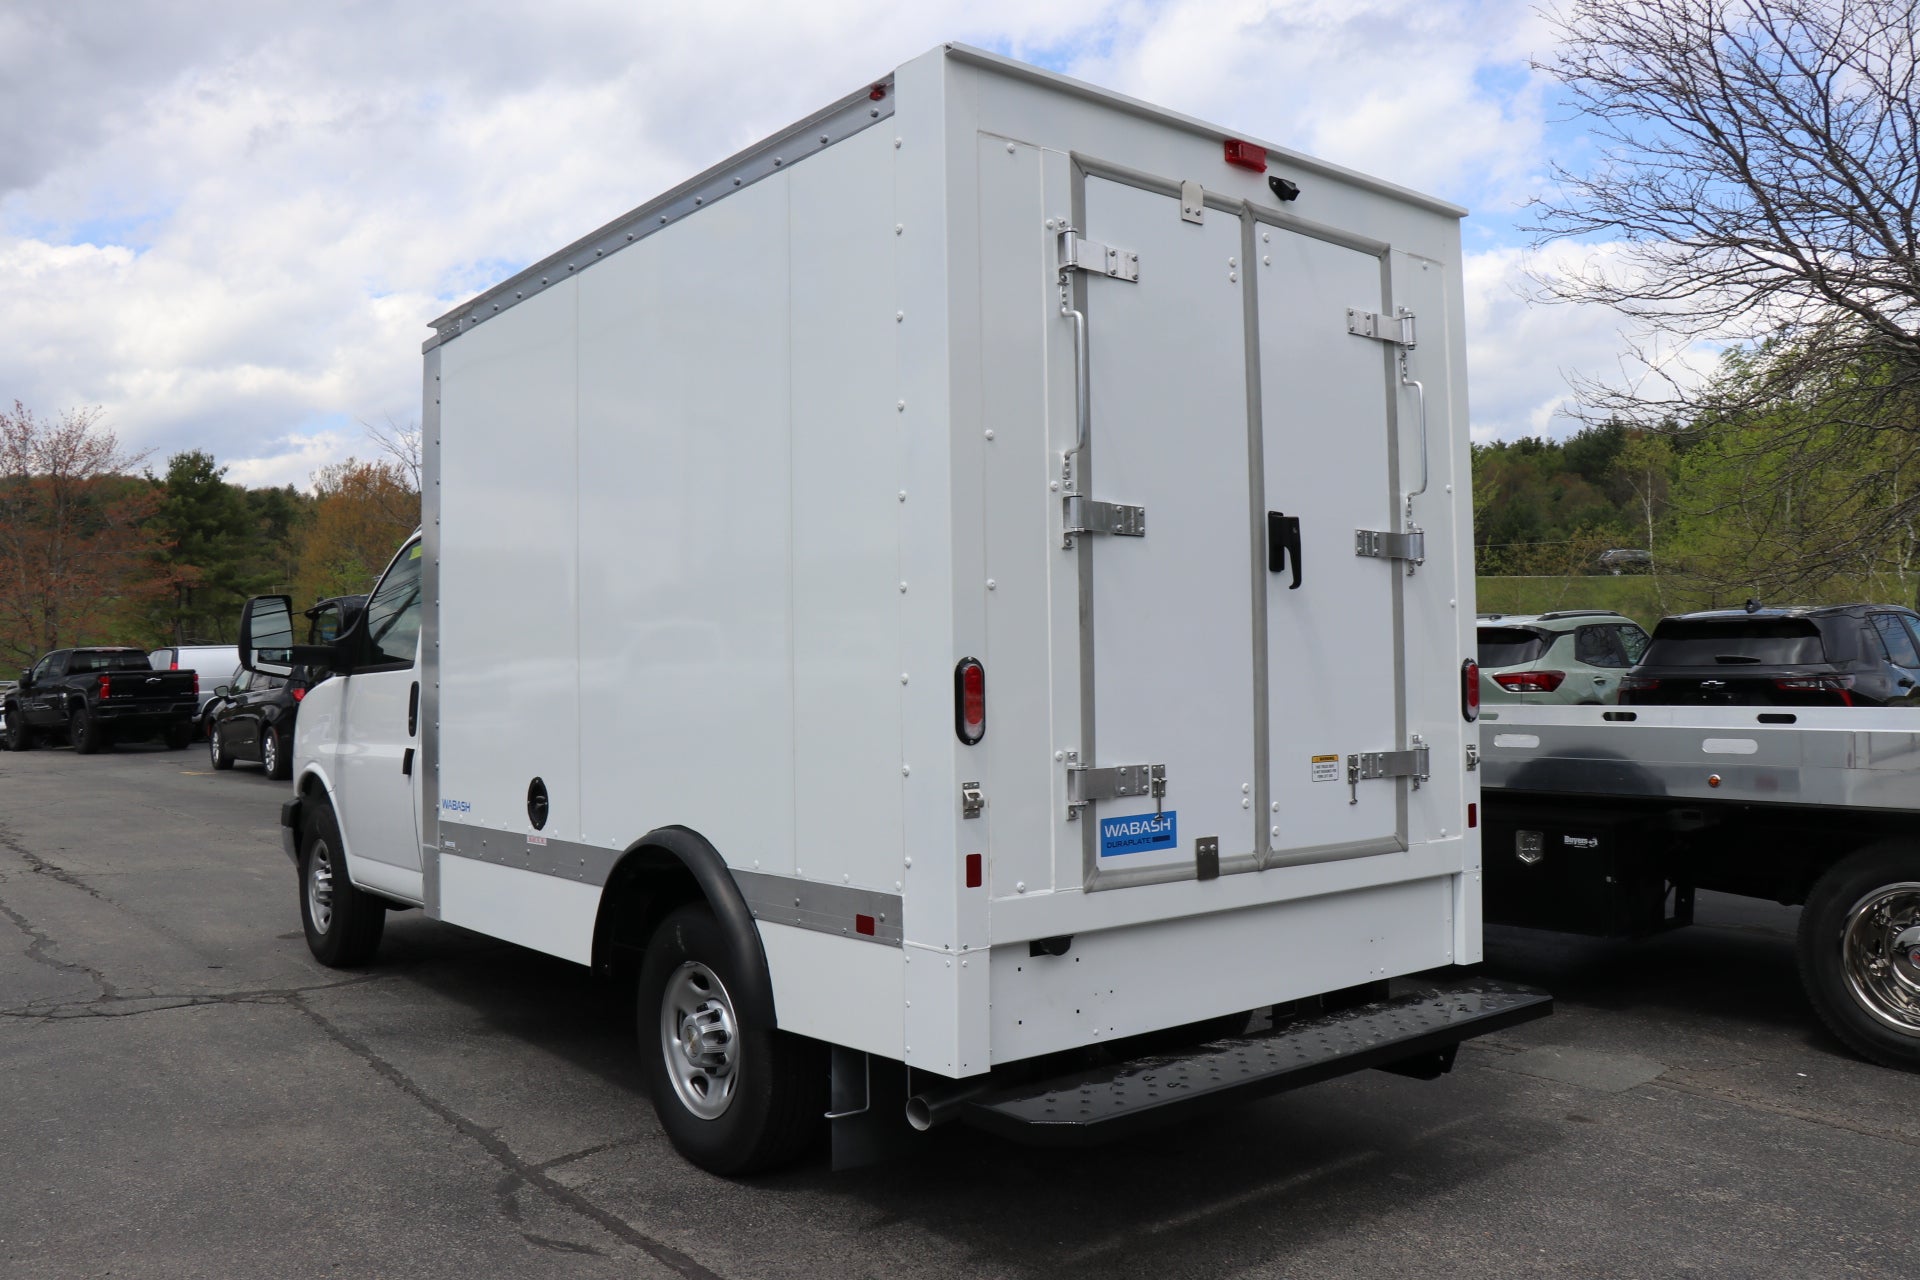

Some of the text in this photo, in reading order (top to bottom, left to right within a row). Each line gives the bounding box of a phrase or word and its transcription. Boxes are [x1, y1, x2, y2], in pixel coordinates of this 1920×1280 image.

[441, 799, 471, 812] WABASH
[1104, 818, 1171, 838] WABASH
[1106, 837, 1152, 849] DURAPLATE
